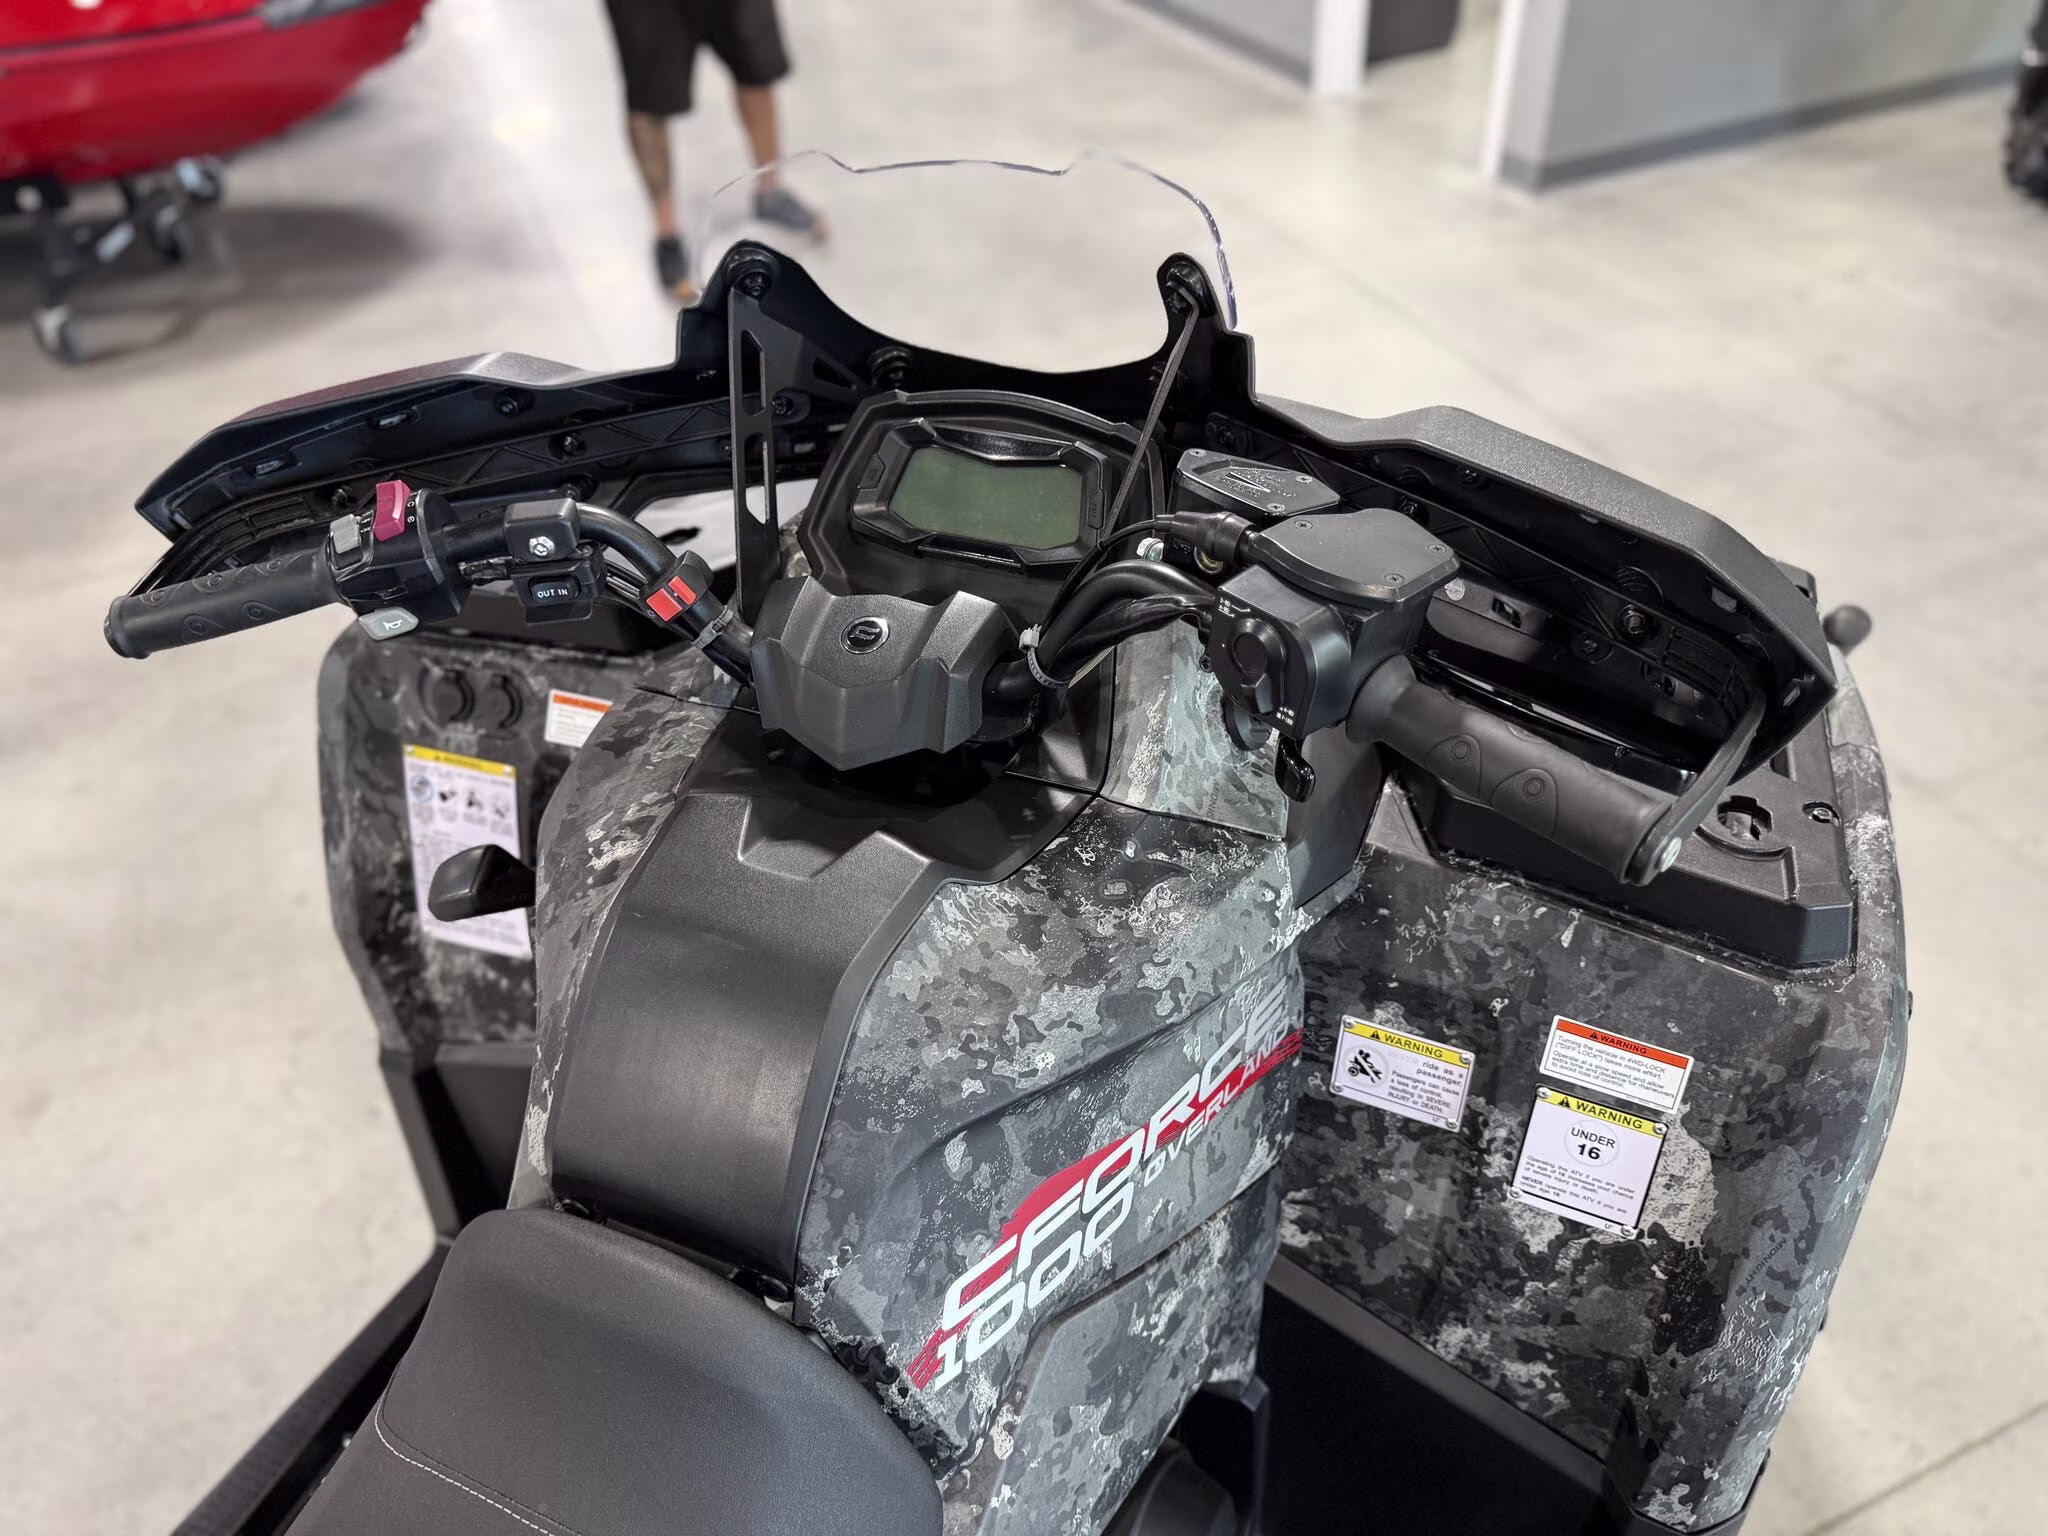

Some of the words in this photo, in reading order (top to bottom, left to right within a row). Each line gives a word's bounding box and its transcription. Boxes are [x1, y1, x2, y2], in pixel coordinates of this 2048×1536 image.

[537, 589, 556, 599] OUT
[558, 588, 568, 596] IN
[1383, 1033, 1443, 1058] WARNING
[1582, 1043, 1593, 1051] the
[1599, 1034, 1647, 1054] WARNING
[1422, 1061, 1438, 1071] ride
[1552, 1050, 1579, 1063] Operate
[1594, 1063, 1609, 1071] slow
[1610, 1068, 1631, 1079] speed
[1631, 1075, 1645, 1083] and
[1623, 1063, 1641, 1072] more
[1391, 1070, 1425, 1086] Passengers
[1441, 1086, 1459, 1096] cause
[1416, 1068, 1462, 1087] passenger.
[1143, 1022, 1291, 1188] OVERLAND
[1387, 1091, 1410, 1102] INJURY
[1575, 1100, 1643, 1130] WARNING
[1570, 1126, 1616, 1148] UNDER
[941, 979, 1287, 1332] CFORCE
[1576, 1141, 1601, 1160] 16
[1745, 1237, 1787, 1285] MIDNIGHT
[934, 1180, 1134, 1391] 1000
